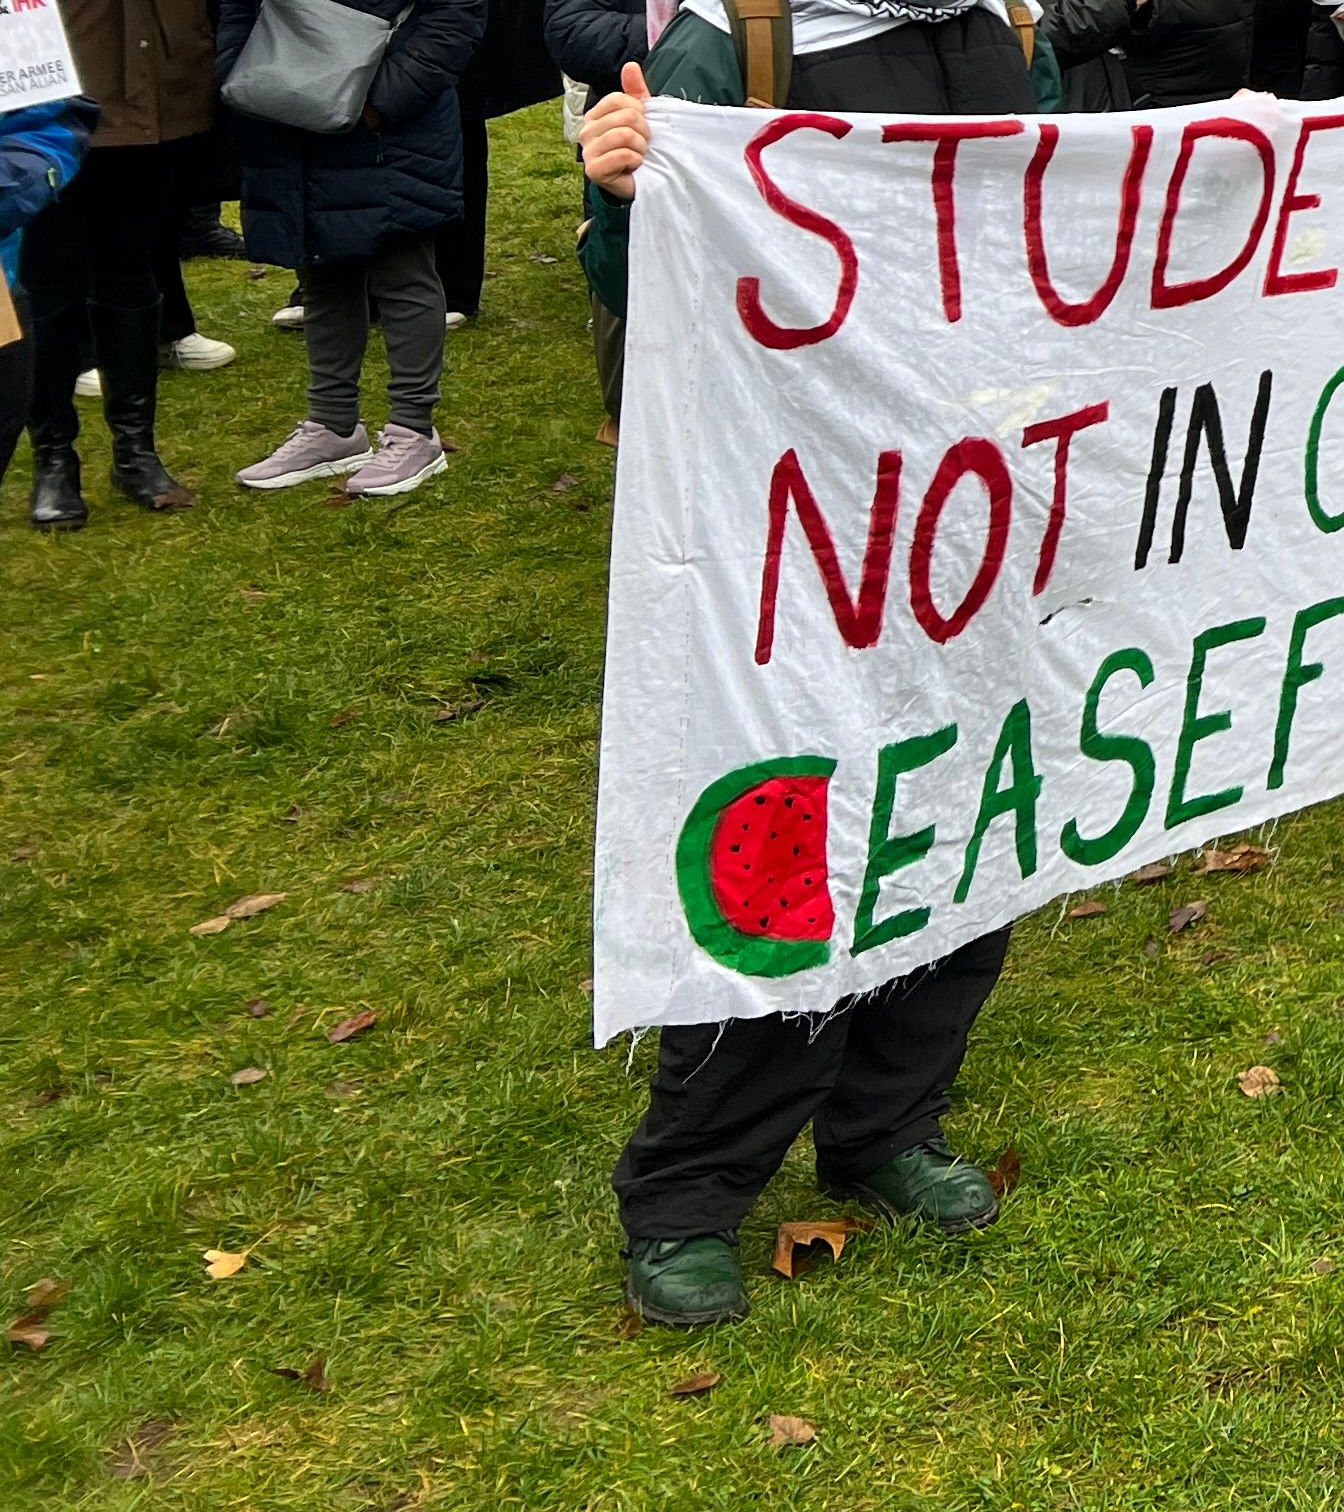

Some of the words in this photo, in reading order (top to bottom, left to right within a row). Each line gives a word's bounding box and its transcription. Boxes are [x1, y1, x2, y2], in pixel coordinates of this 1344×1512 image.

[20, 59, 64, 80] ARMEE
[753, 400, 1110, 666] NOT
[1132, 368, 1273, 571] IN
